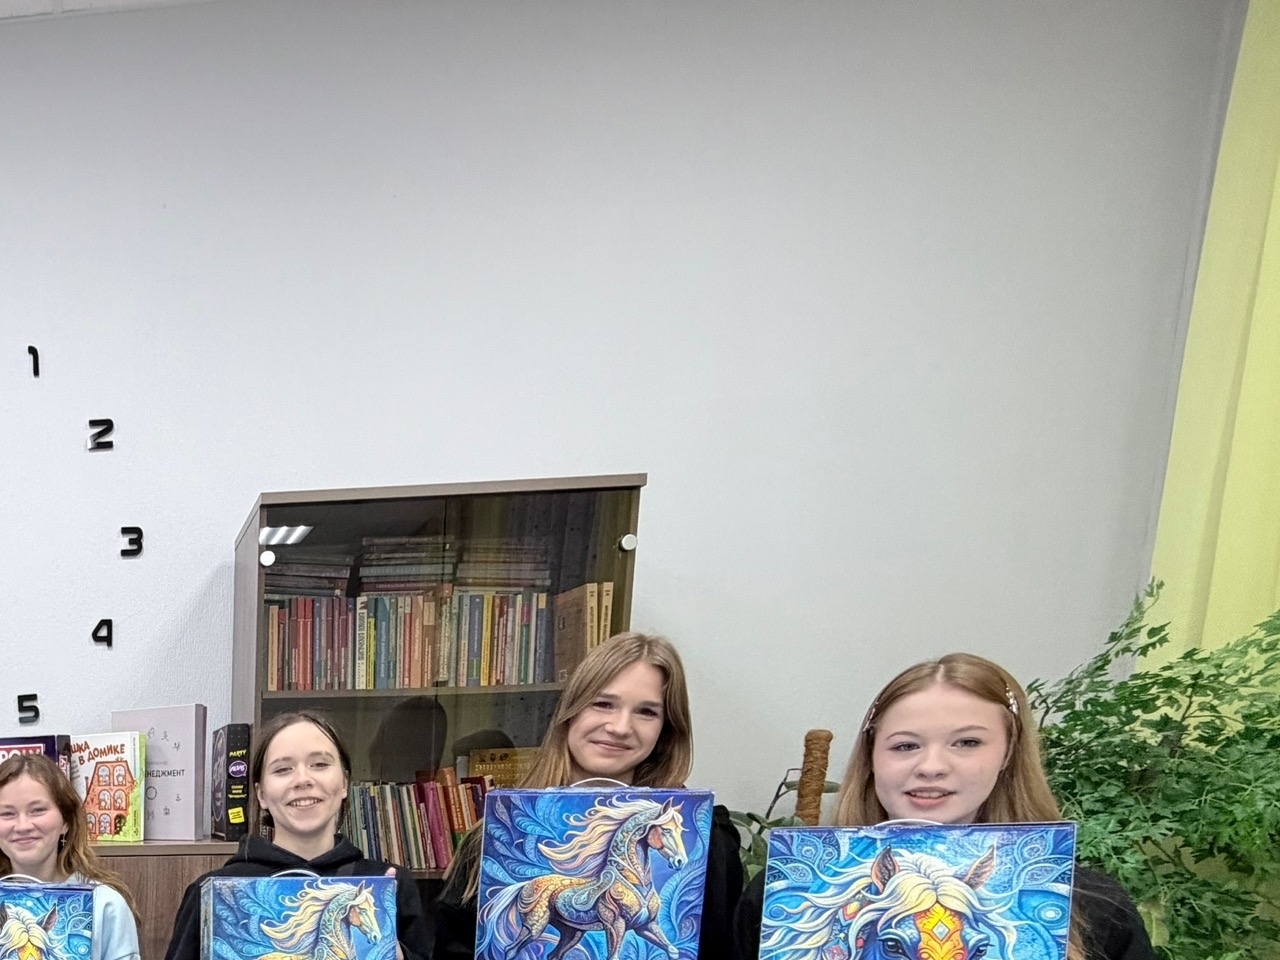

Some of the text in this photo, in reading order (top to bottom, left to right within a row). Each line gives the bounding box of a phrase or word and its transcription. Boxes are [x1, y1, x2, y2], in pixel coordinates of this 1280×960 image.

[27, 345, 40, 378] 1
[88, 418, 114, 451] 2
[120, 526, 144, 558] 3
[91, 618, 113, 648] 4
[17, 693, 40, 724] 5
[70, 741, 90, 754] ШКА
[78, 755, 86, 766] В
[87, 743, 126, 763] ДОМИКЕ
[229, 749, 247, 758] PARTY
[145, 769, 185, 778] НЕДЖМЕНТ
